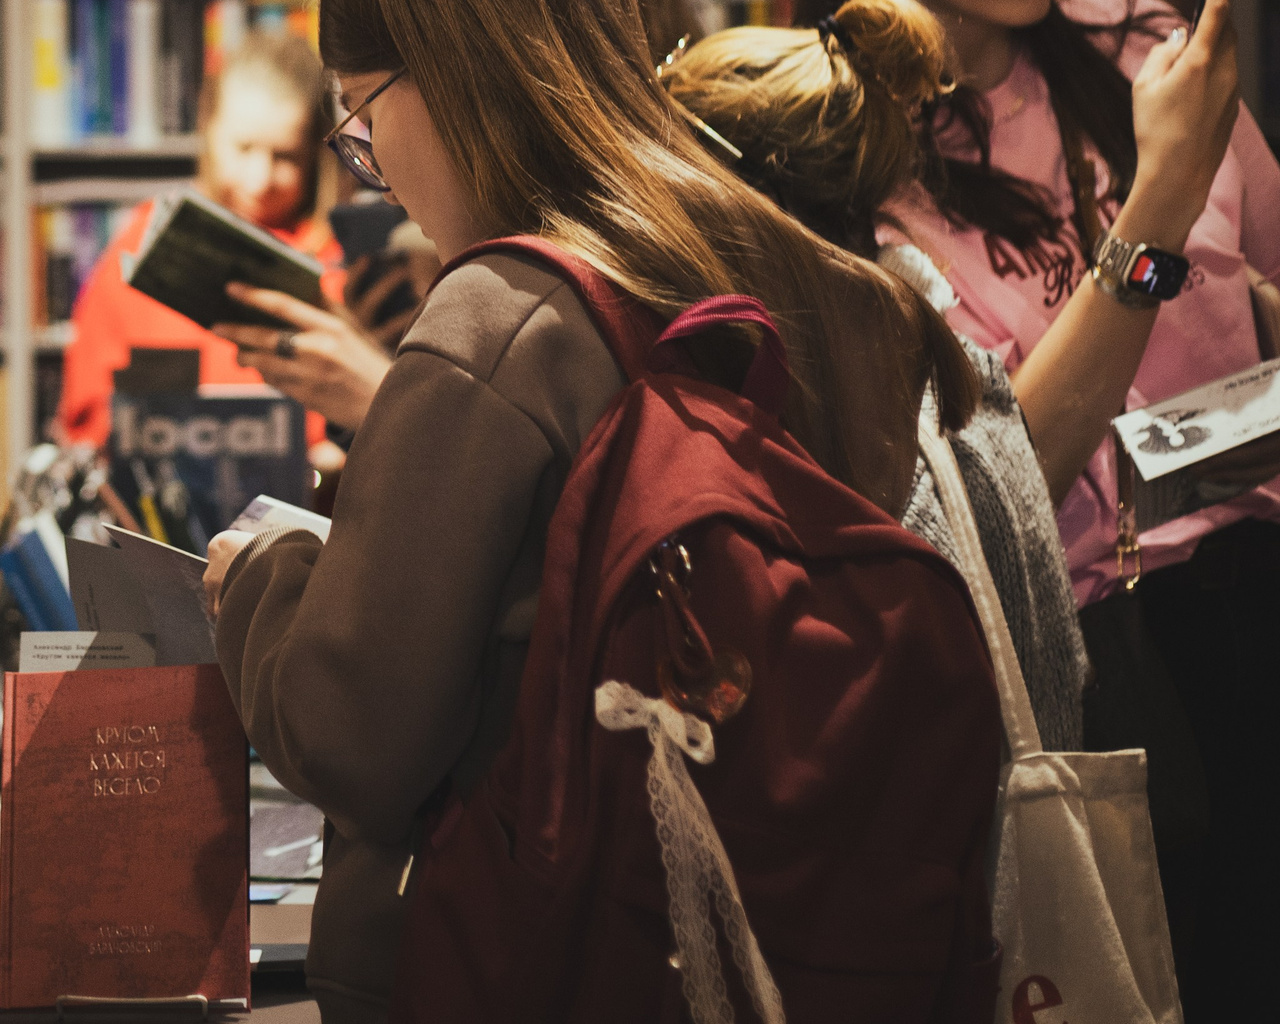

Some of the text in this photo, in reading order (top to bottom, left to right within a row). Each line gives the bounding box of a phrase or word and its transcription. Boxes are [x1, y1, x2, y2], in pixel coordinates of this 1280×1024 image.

[117, 402, 291, 457] local
[96, 725, 160, 744] КРУГОМ
[90, 750, 166, 770] КАЖЕТСЯ
[93, 777, 161, 796] ВЕСЕЛО
